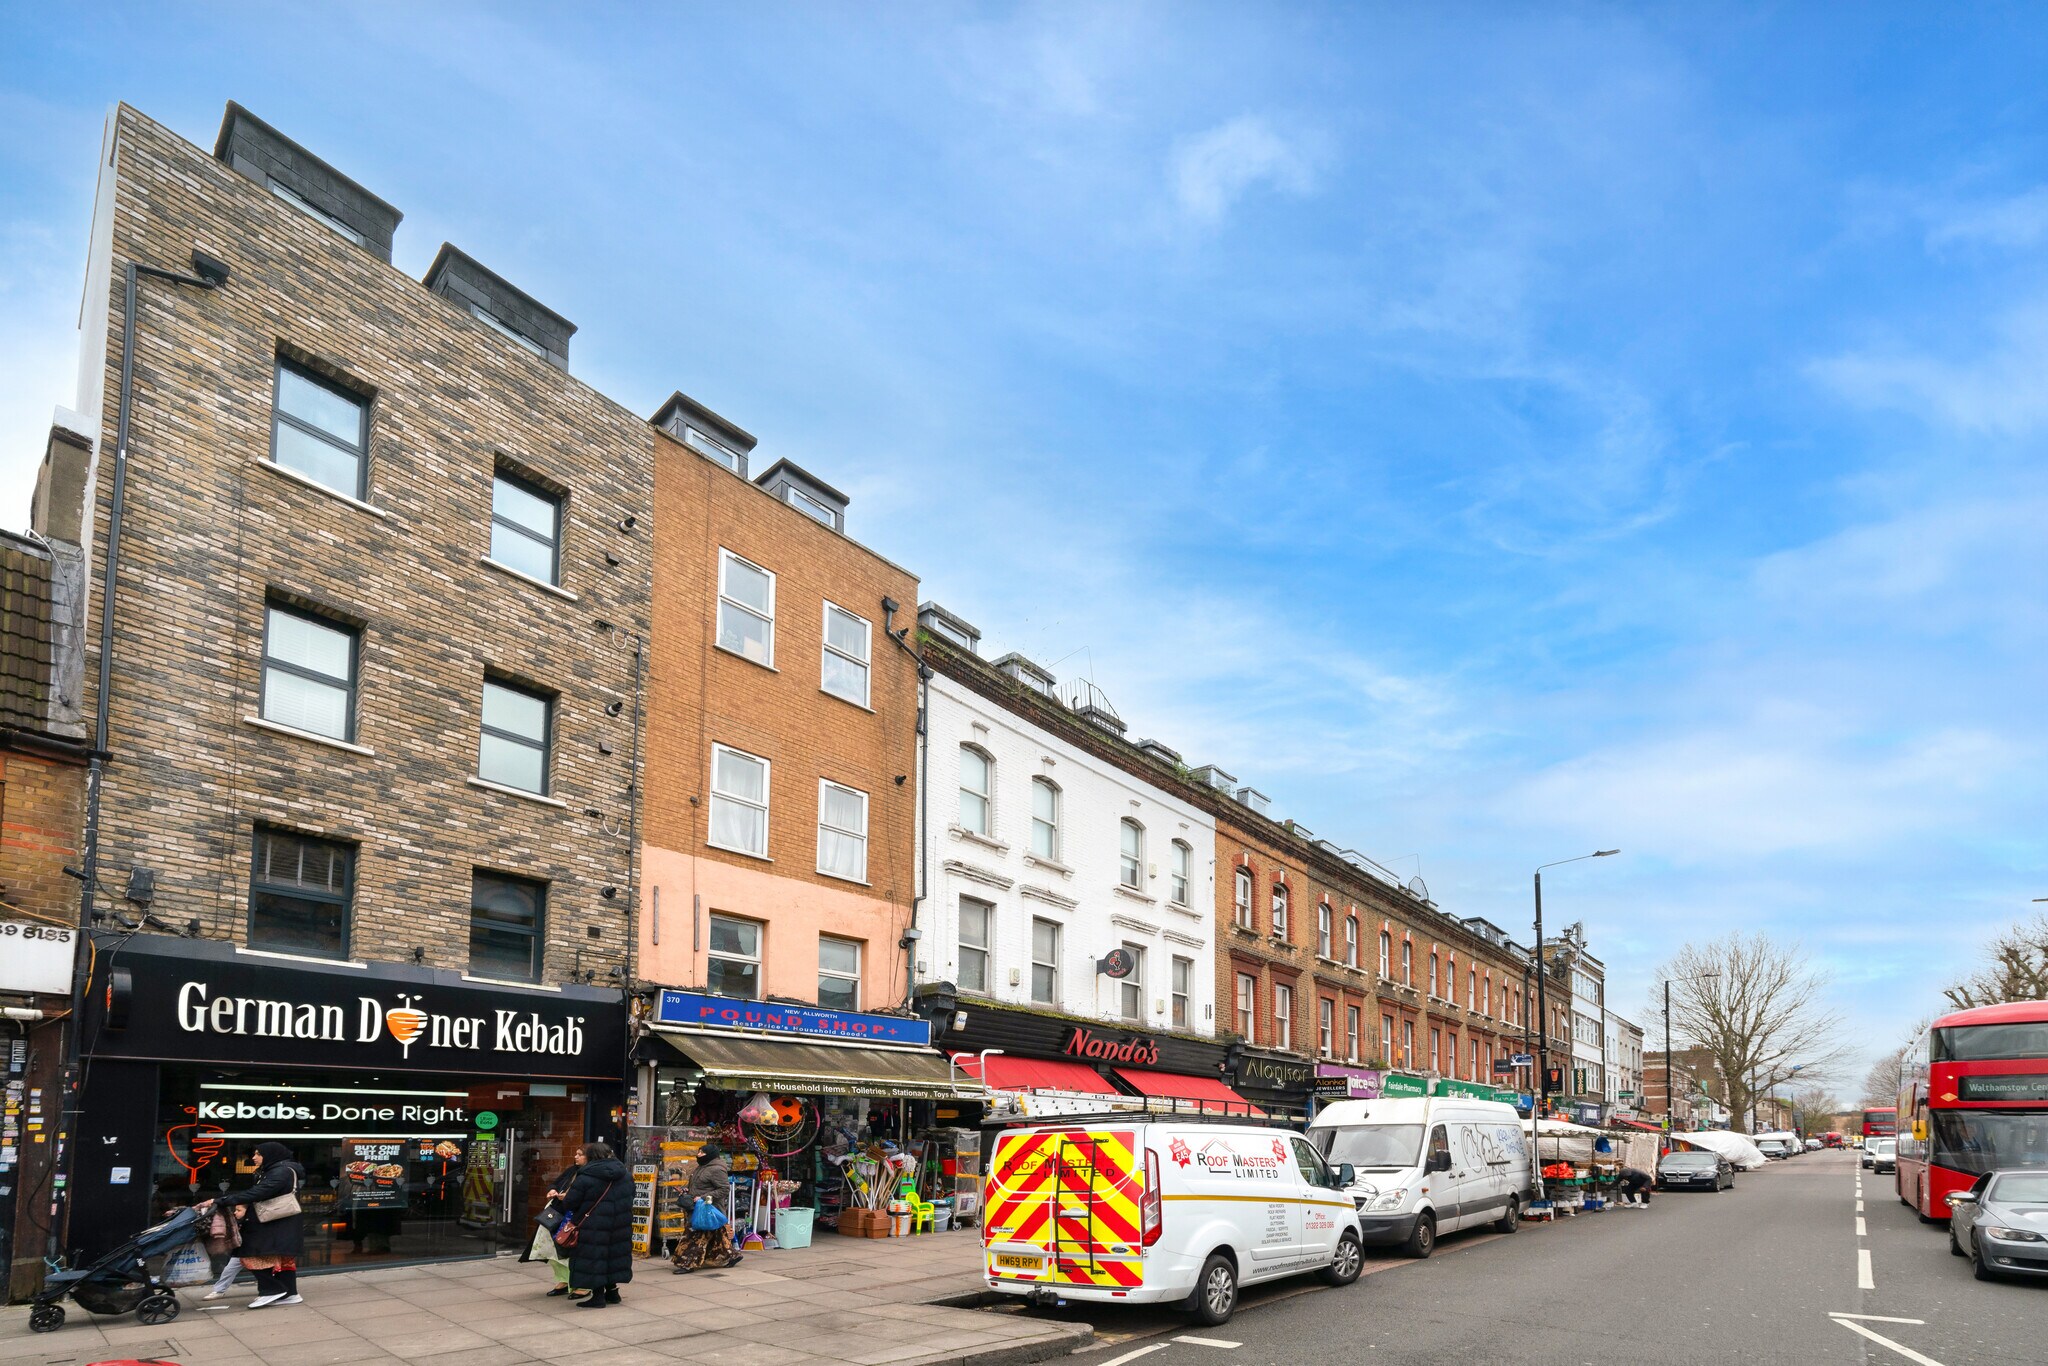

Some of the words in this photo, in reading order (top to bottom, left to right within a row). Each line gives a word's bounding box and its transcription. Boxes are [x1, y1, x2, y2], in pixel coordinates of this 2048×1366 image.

[666, 996, 680, 1004] 370
[177, 981, 346, 1041] German
[699, 1006, 803, 1026] POUND
[802, 1011, 838, 1019] ALLWORTH
[758, 1022, 789, 1031] Price's
[793, 1025, 837, 1035] Household
[840, 1030, 867, 1038] Good's
[1064, 1026, 1160, 1065] Nando's
[751, 1081, 763, 1089] £1
[773, 1082, 821, 1092] Household
[822, 1084, 846, 1093] items
[892, 1088, 928, 1098] Stationary
[933, 1090, 949, 1099] Toys
[1969, 1083, 2028, 1092] Walthamstow
[198, 1101, 316, 1120] Kebabs.
[322, 1103, 395, 1121] Done
[401, 1105, 469, 1126] Right.
[1176, 1150, 1189, 1162] £45
[1197, 1152, 1228, 1167] ROOF
[1232, 1154, 1276, 1168] MASTERS
[349, 1173, 366, 1181] GDK
[1235, 1169, 1278, 1179] LIMITED
[999, 1256, 1021, 1266] HW69
[1022, 1257, 1039, 1268] RPY
